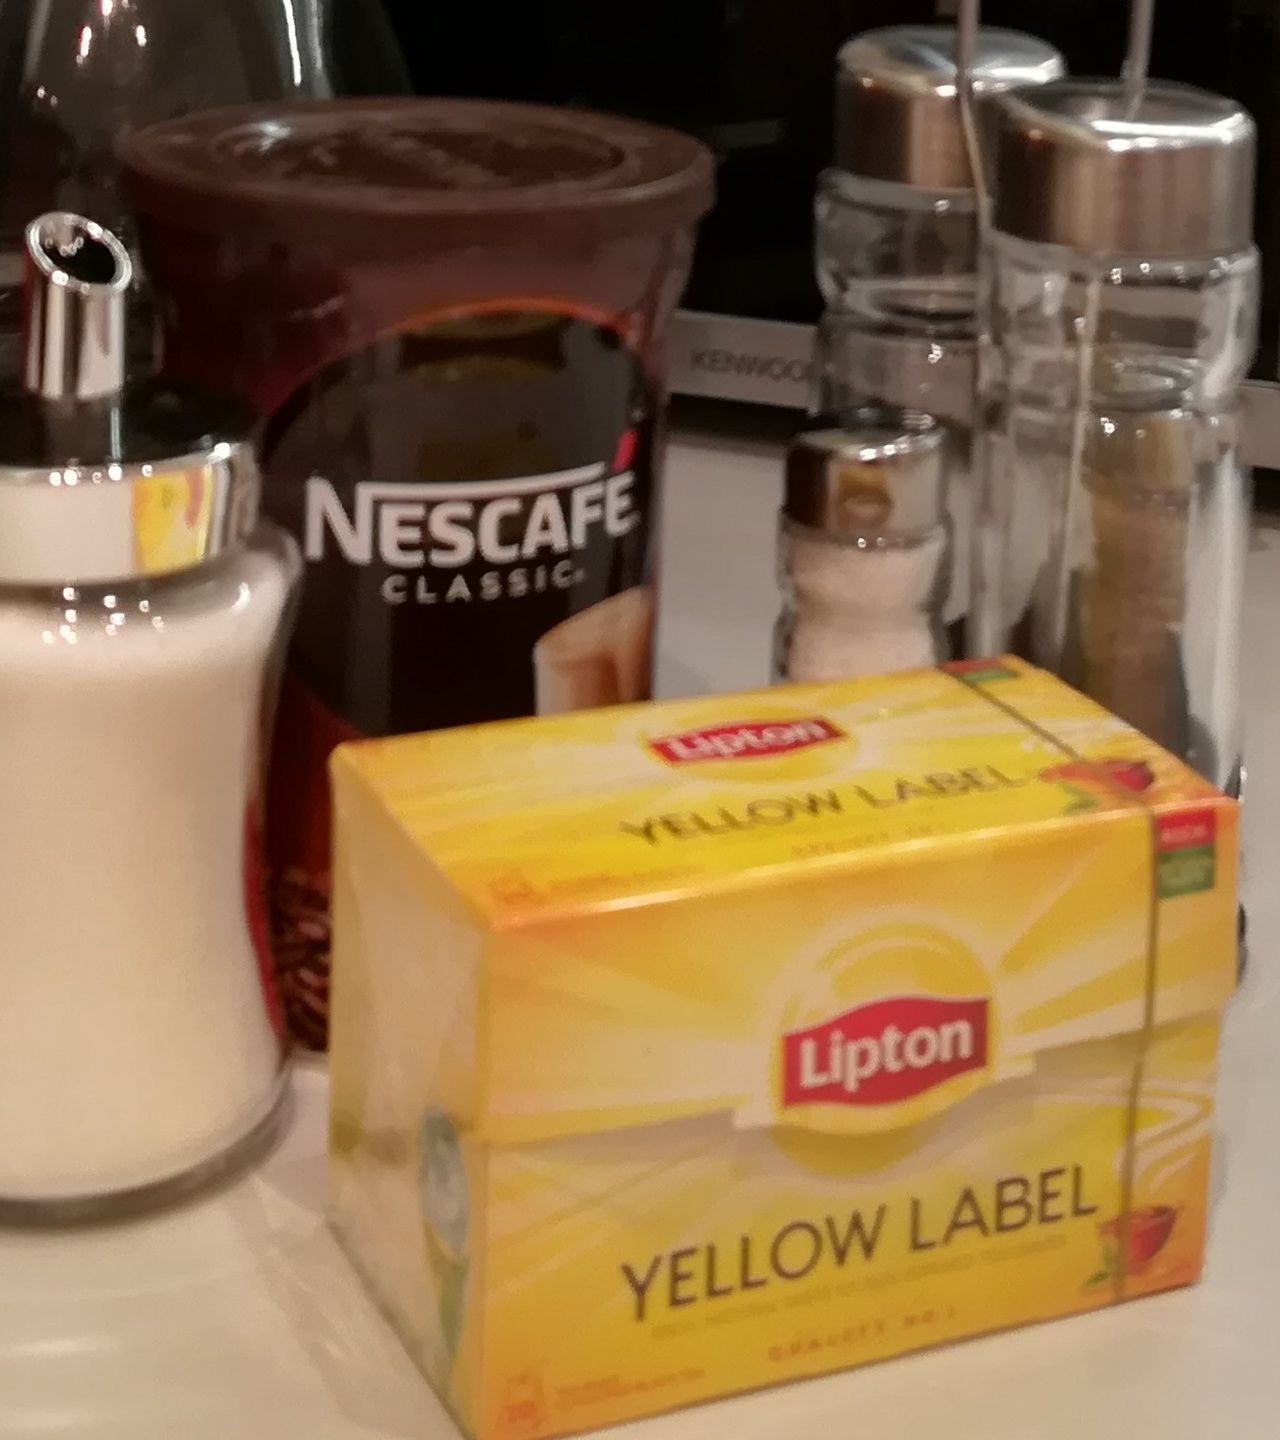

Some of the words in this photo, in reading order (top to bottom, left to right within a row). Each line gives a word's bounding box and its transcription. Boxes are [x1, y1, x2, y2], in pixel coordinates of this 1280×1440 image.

[667, 720, 828, 761] Lipton
[619, 786, 847, 848] YELLOW
[852, 761, 1026, 811] LABEL
[796, 1017, 974, 1094] Lipton
[620, 1203, 888, 1323] YELLOW
[909, 1163, 1099, 1254] LABEL
